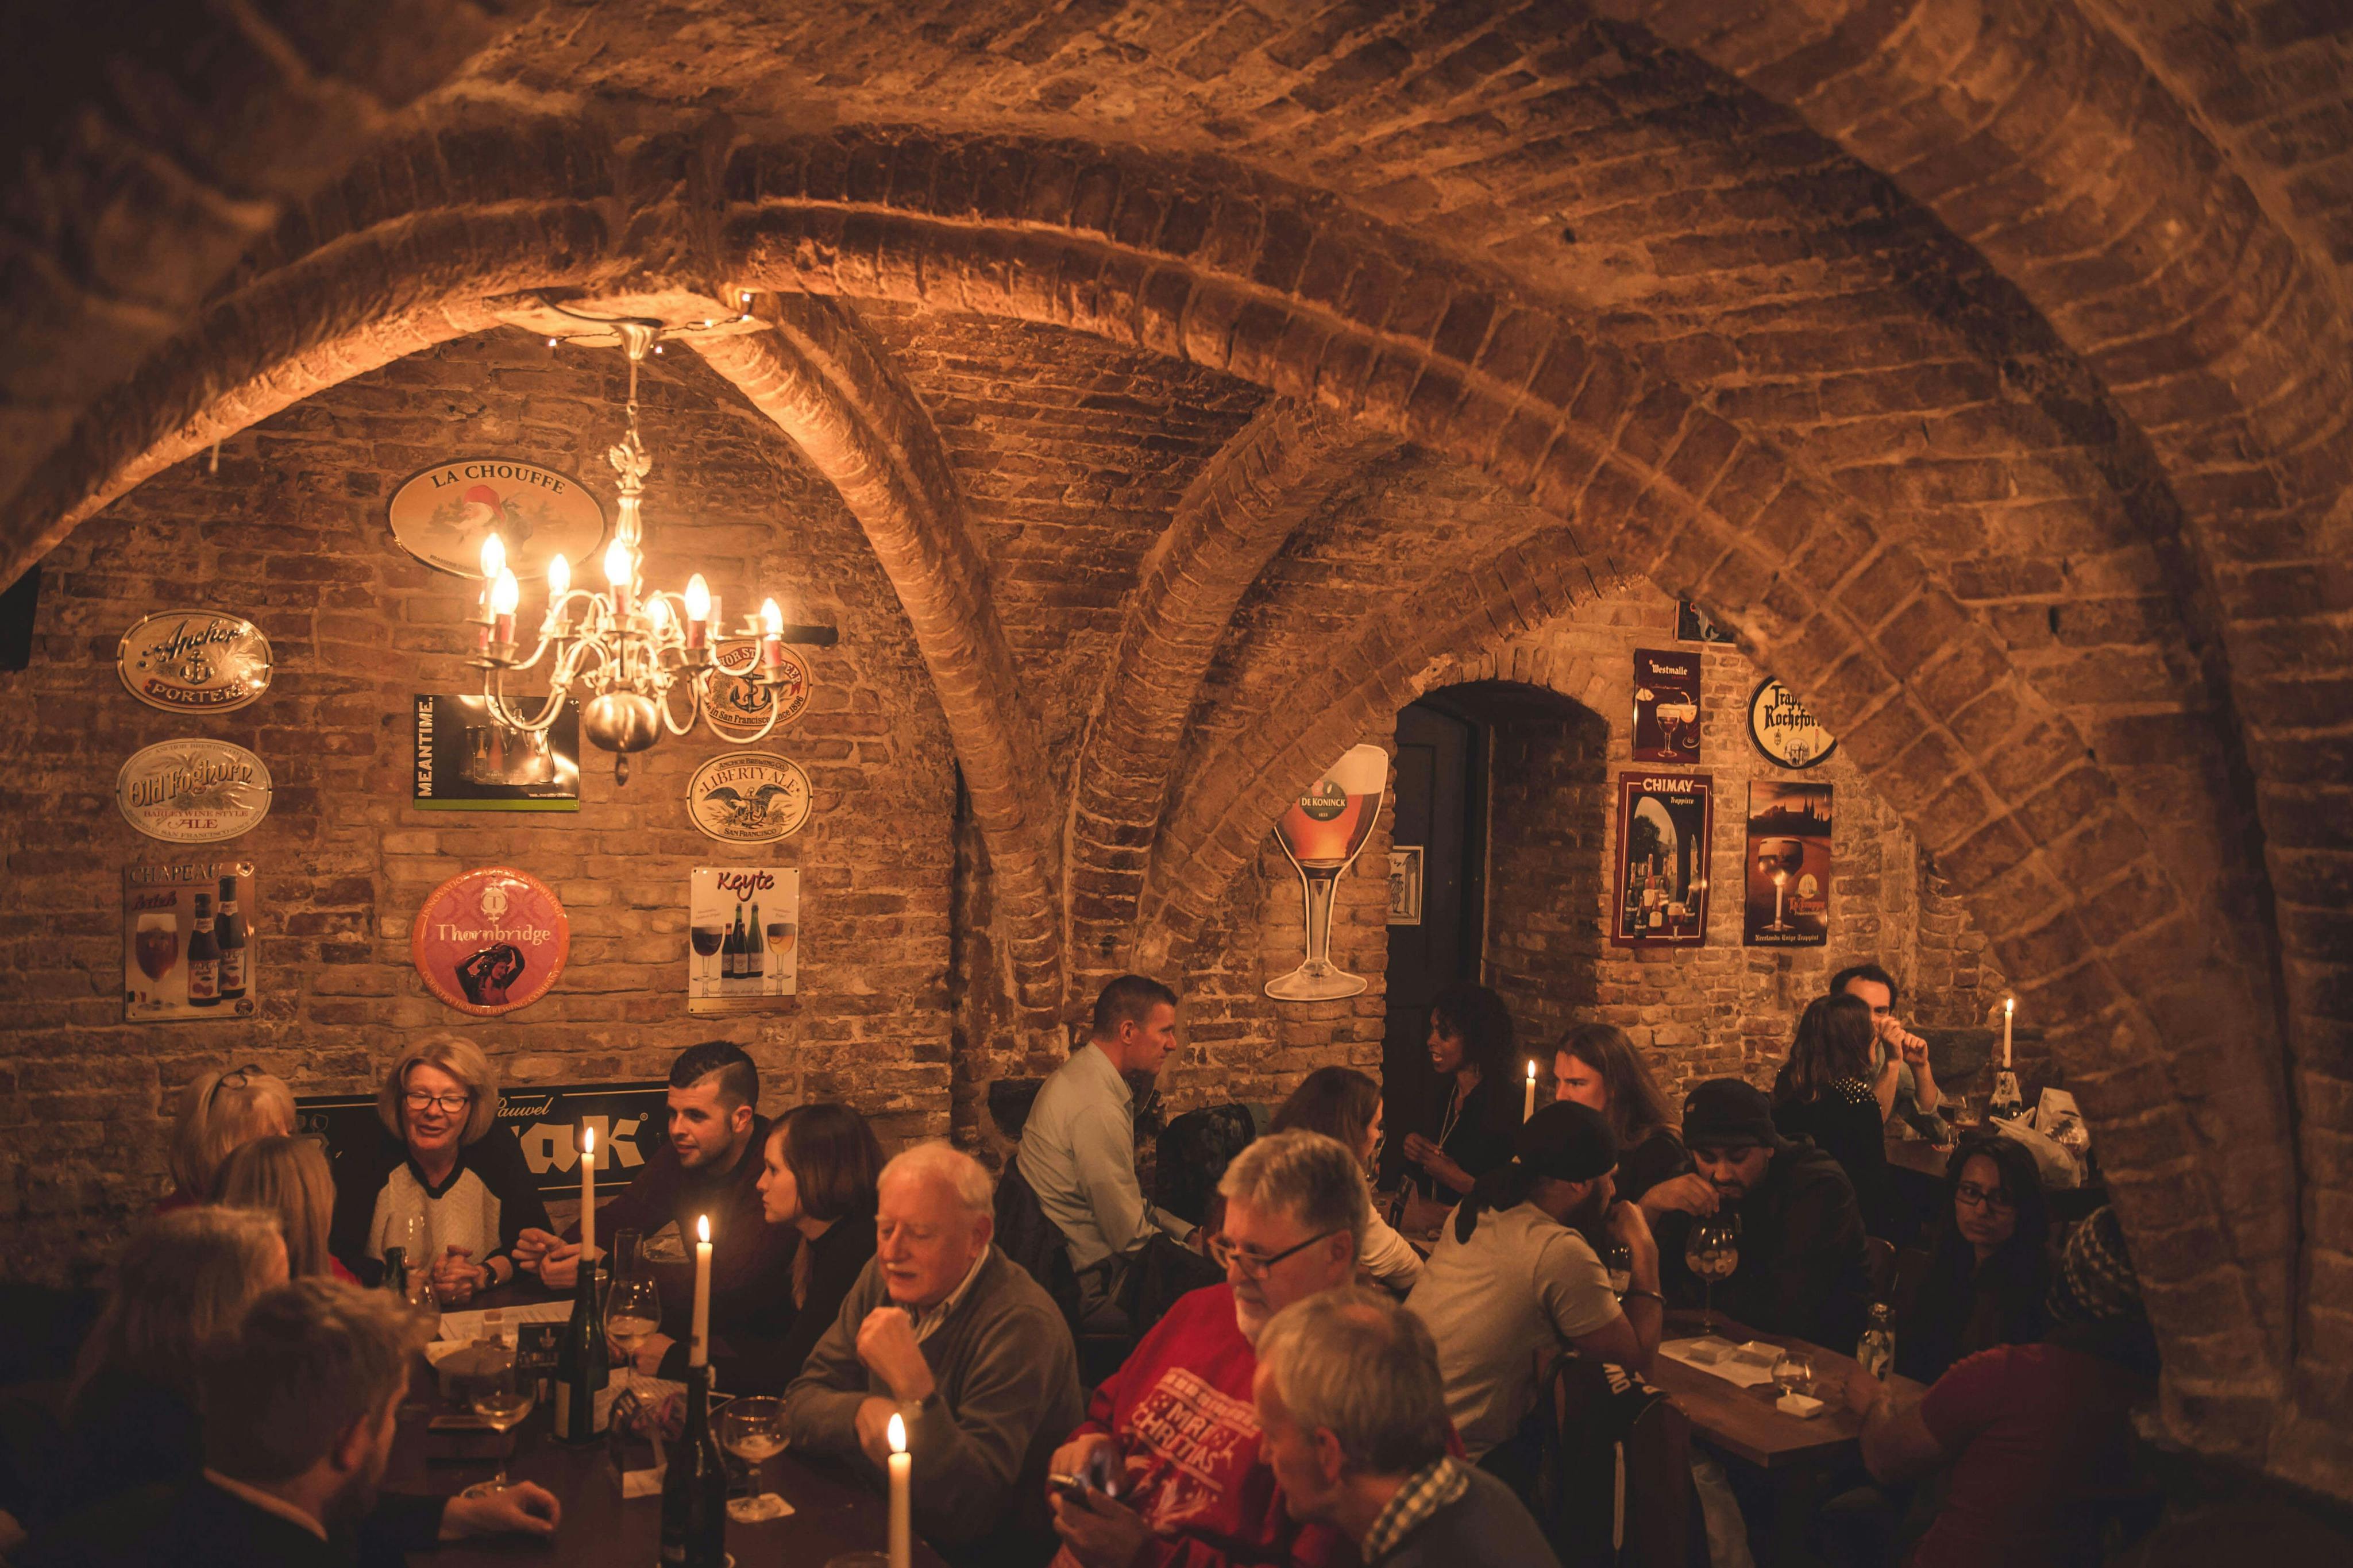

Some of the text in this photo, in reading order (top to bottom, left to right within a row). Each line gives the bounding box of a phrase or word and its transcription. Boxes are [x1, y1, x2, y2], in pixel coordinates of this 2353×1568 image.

[430, 465, 566, 495] LA CHOUFFE
[137, 619, 242, 670] Anchor
[781, 662, 801, 685] EER
[1652, 663, 1688, 675] Westmalle
[152, 682, 248, 702] PORTER
[710, 695, 804, 724] in San Francisco ince 1896
[128, 758, 253, 808] Old Foghorn
[702, 767, 798, 793] LIBERTY ALE
[1642, 777, 1694, 792] CHIMAY
[1301, 797, 1345, 806] DE KONINCK
[1670, 796, 1694, 805] Trappiste
[161, 828, 178, 838] SAN
[180, 829, 230, 839] FRANCISCO
[167, 819, 218, 829] ALE
[724, 828, 777, 837] SAN FRANCISCO
[129, 863, 223, 883] CHAPEAU
[717, 870, 775, 902] Keyte
[435, 924, 551, 945] Thornbridge
[422, 971, 561, 1014] COUNTRY HOUSE BREWING COMPANY
